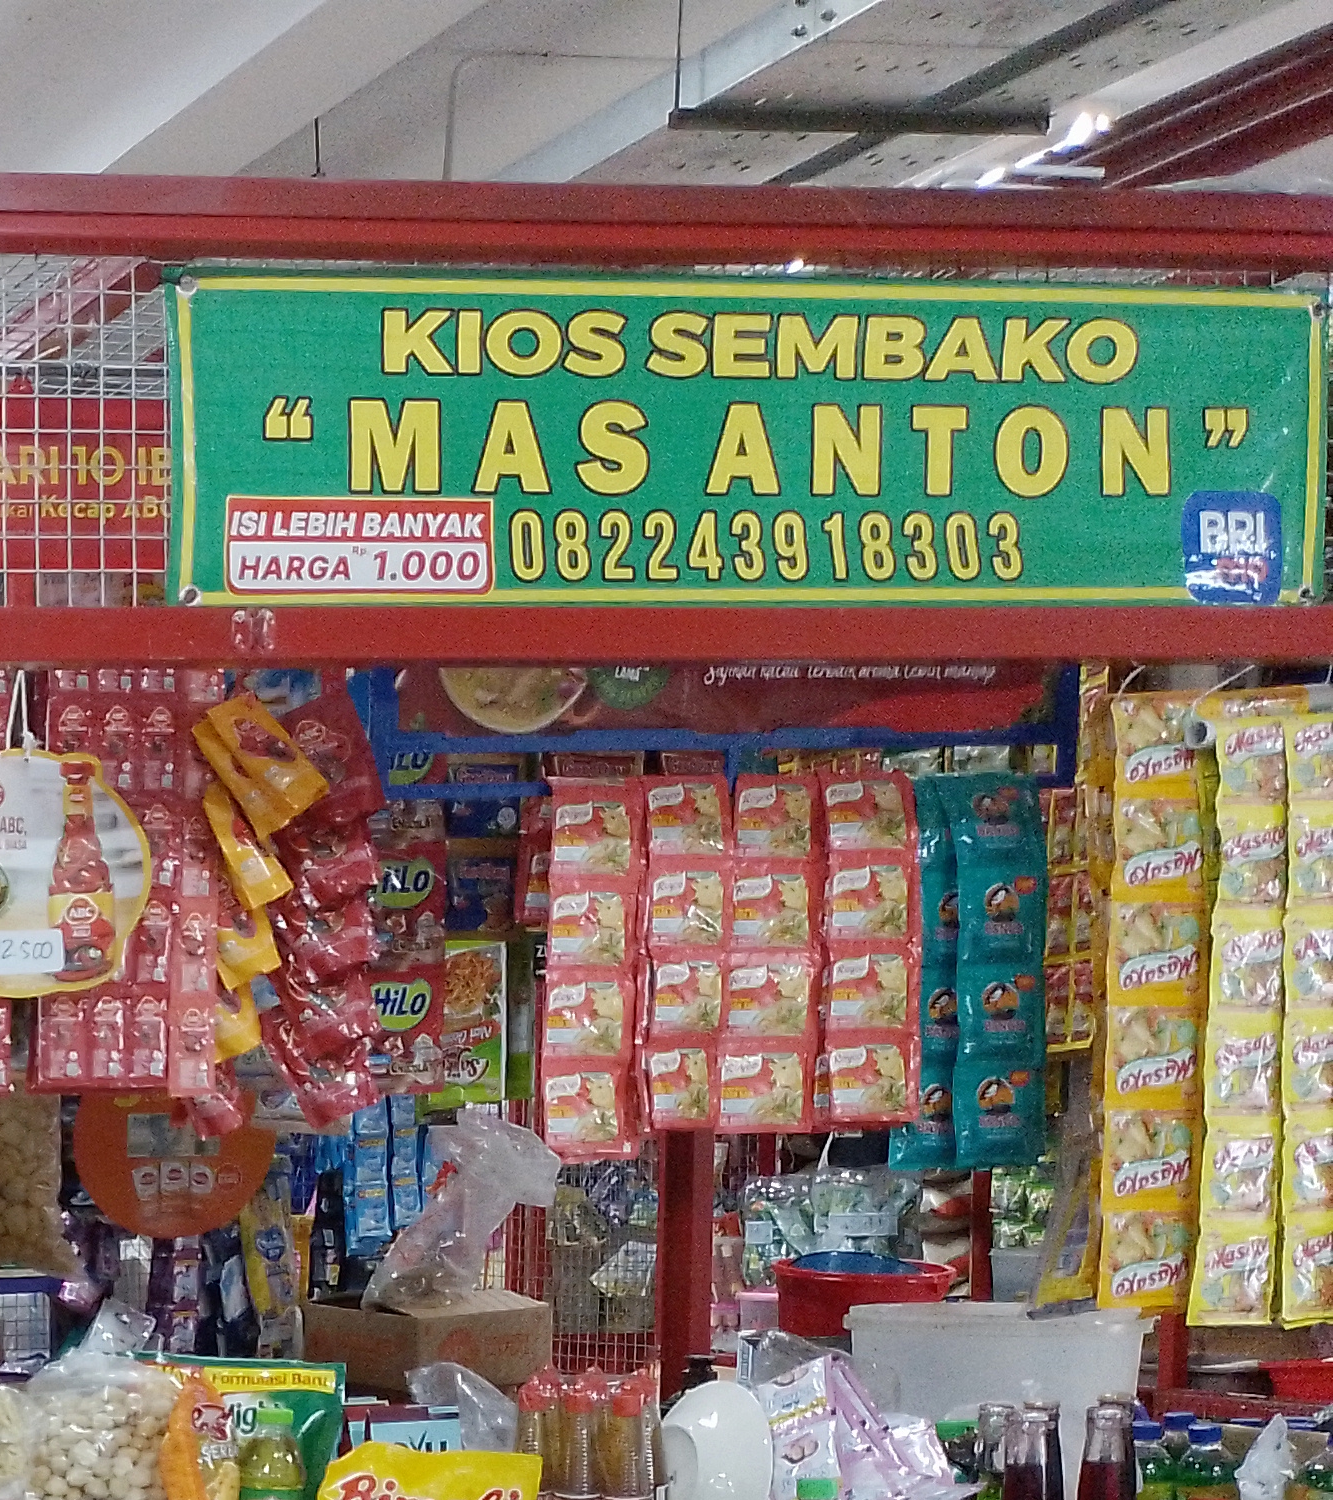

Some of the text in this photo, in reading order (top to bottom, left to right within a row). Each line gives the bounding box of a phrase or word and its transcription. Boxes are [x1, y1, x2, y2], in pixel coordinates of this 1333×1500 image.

[380, 308, 1139, 384] KIOS SEMBAKO
[70, 446, 125, 486] 10
[40, 498, 114, 524] Kecap
[273, 511, 357, 538] LEBIH
[362, 512, 486, 539] BANYAK
[508, 509, 1023, 582] 082243918303
[238, 556, 351, 581] HARGA
[373, 550, 481, 582] 1.000
[1128, 850, 1203, 886] Masako
[1123, 948, 1200, 989] Masako
[1119, 1051, 1197, 1093] Masako
[1116, 1157, 1191, 1196] Masako
[1114, 1254, 1189, 1296] Masako
